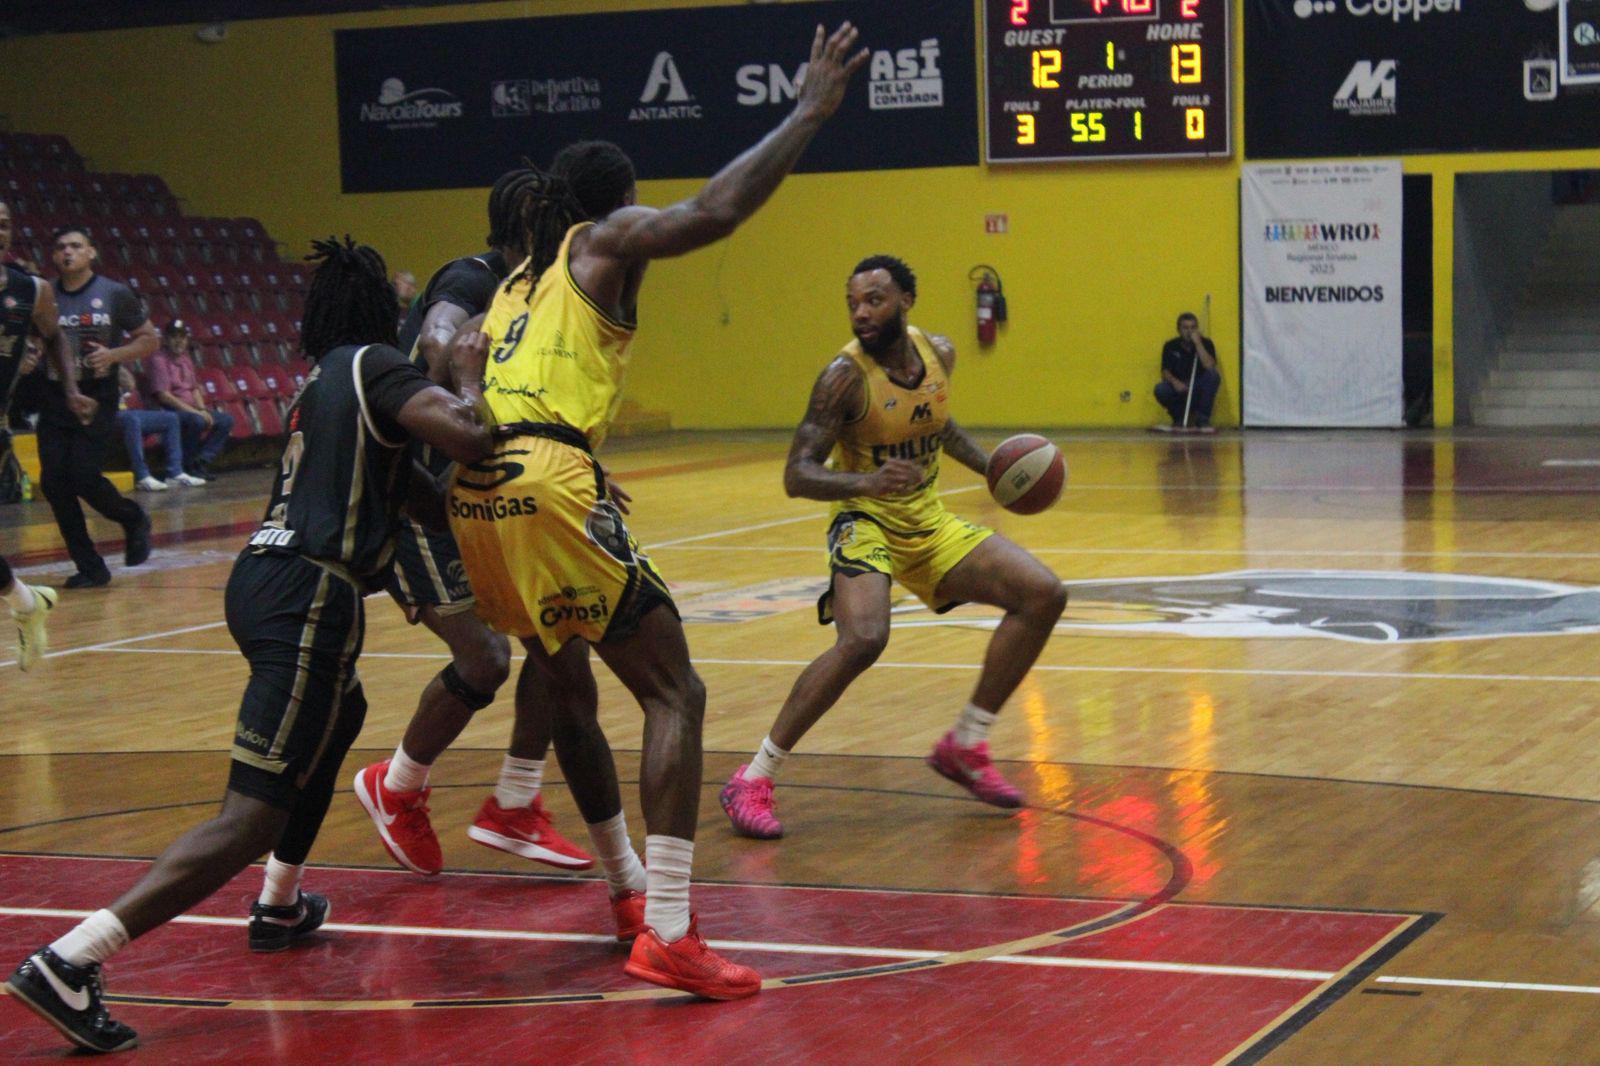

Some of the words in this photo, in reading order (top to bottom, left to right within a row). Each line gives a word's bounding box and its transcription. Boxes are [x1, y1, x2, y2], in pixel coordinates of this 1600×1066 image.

[1004, 28, 1066, 46] GUEST
[1146, 23, 1204, 40] HOME
[870, 38, 940, 80] ASÍ
[1106, 41, 1114, 71] 1
[1171, 43, 1202, 84] 13
[1032, 49, 1062, 89] 12
[874, 84, 893, 94] ME
[895, 83, 912, 93] LO
[1077, 74, 1134, 89] PERIOD
[874, 92, 939, 105] CONTARON
[1003, 101, 1041, 112] FOULS
[1065, 96, 1147, 110] PLAYER-FOUL
[1172, 95, 1211, 106] FOULS
[628, 105, 703, 121] ANTARTIC
[1016, 114, 1035, 145] 3
[1070, 112, 1106, 143] 55
[1134, 111, 1142, 141] 1
[1185, 108, 1205, 140] 0
[1320, 223, 1370, 242] WRO
[1265, 286, 1384, 302] BIENVENIDOS
